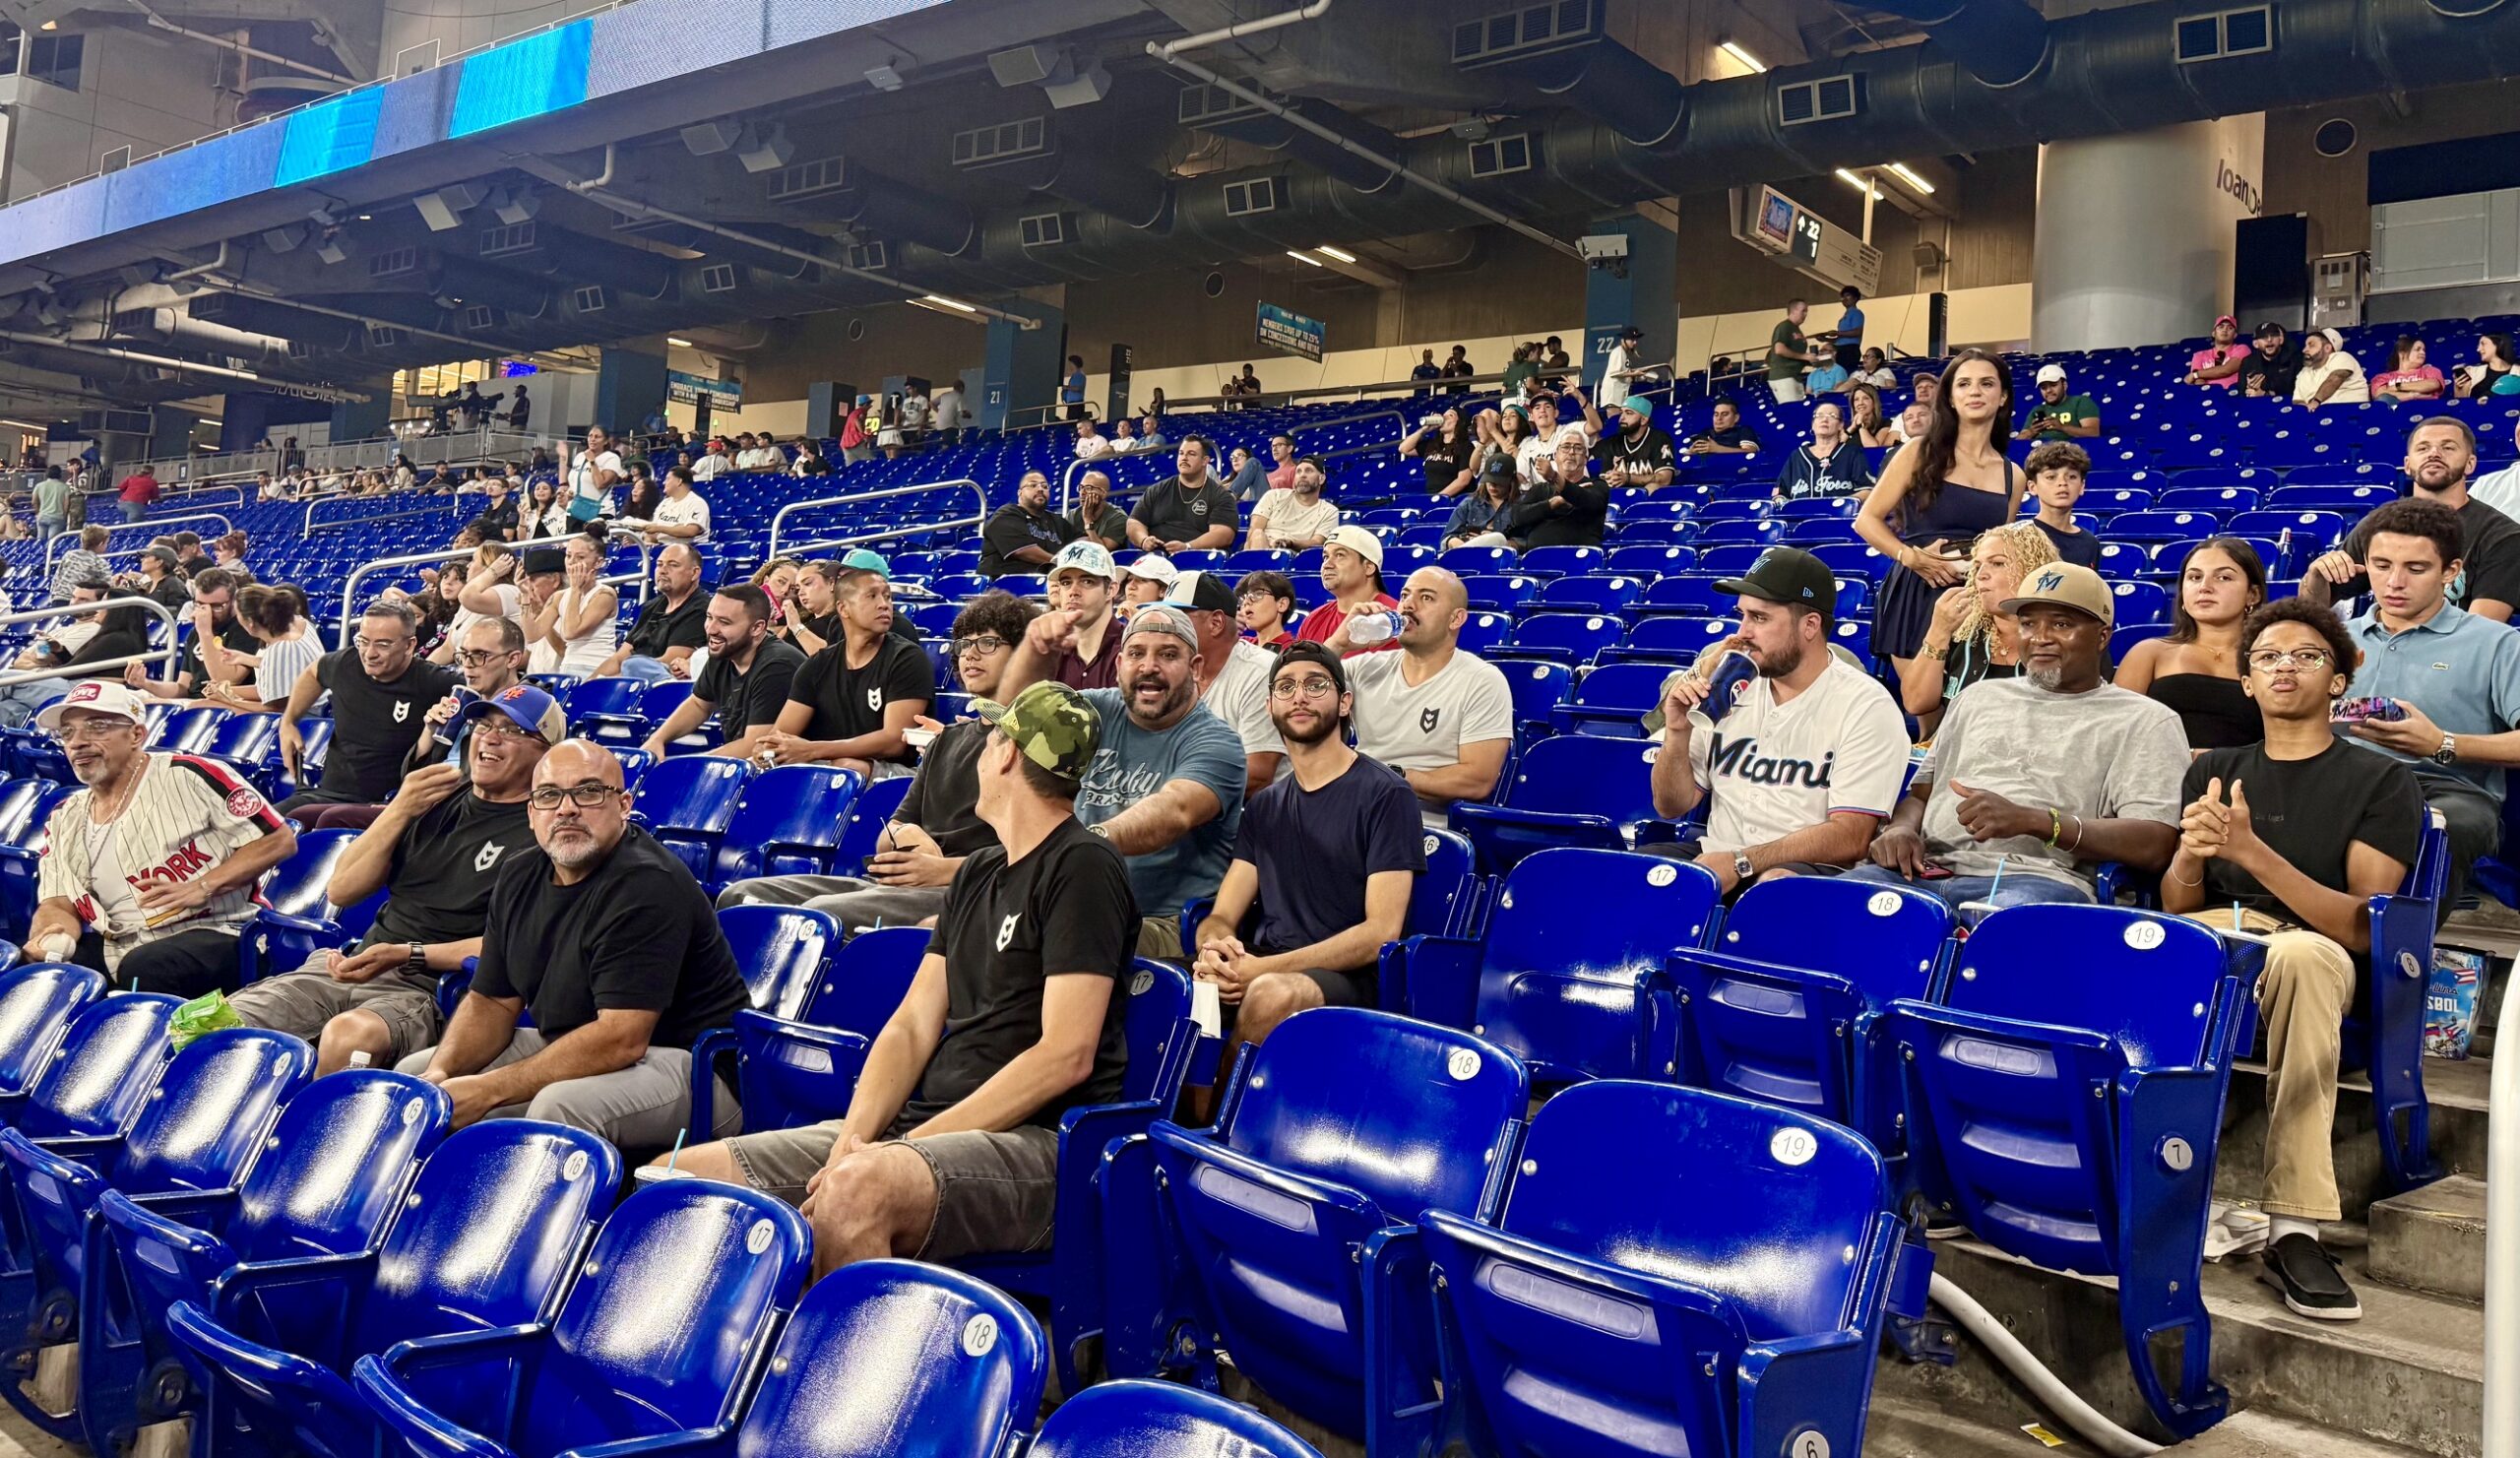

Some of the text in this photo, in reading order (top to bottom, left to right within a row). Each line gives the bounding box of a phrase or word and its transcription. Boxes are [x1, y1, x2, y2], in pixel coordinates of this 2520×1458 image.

[1807, 220, 1820, 240] 22
[1811, 242, 1817, 258] 1
[1597, 337, 1615, 353] 22
[990, 390, 1001, 405] 21
[1814, 475, 1854, 492] Force
[1712, 732, 1835, 790] Miami
[1423, 837, 1437, 856] 16
[126, 840, 214, 892] YORK
[1656, 868, 1671, 882] 17
[1878, 896, 1894, 912] 18
[801, 919, 815, 939] 15
[2136, 926, 2156, 943] 19
[2406, 956, 2415, 973] 8
[1133, 975, 1150, 990] 17
[2426, 995, 2459, 1013] SBOL
[1456, 1055, 1473, 1074] 18
[408, 1103, 421, 1119] 15
[1784, 1135, 1805, 1157] 19
[2172, 1143, 2180, 1164] 7
[571, 1157, 584, 1176] 16
[753, 1226, 771, 1247] 17
[972, 1321, 991, 1349] 18
[1806, 1439, 1819, 1458] 6
